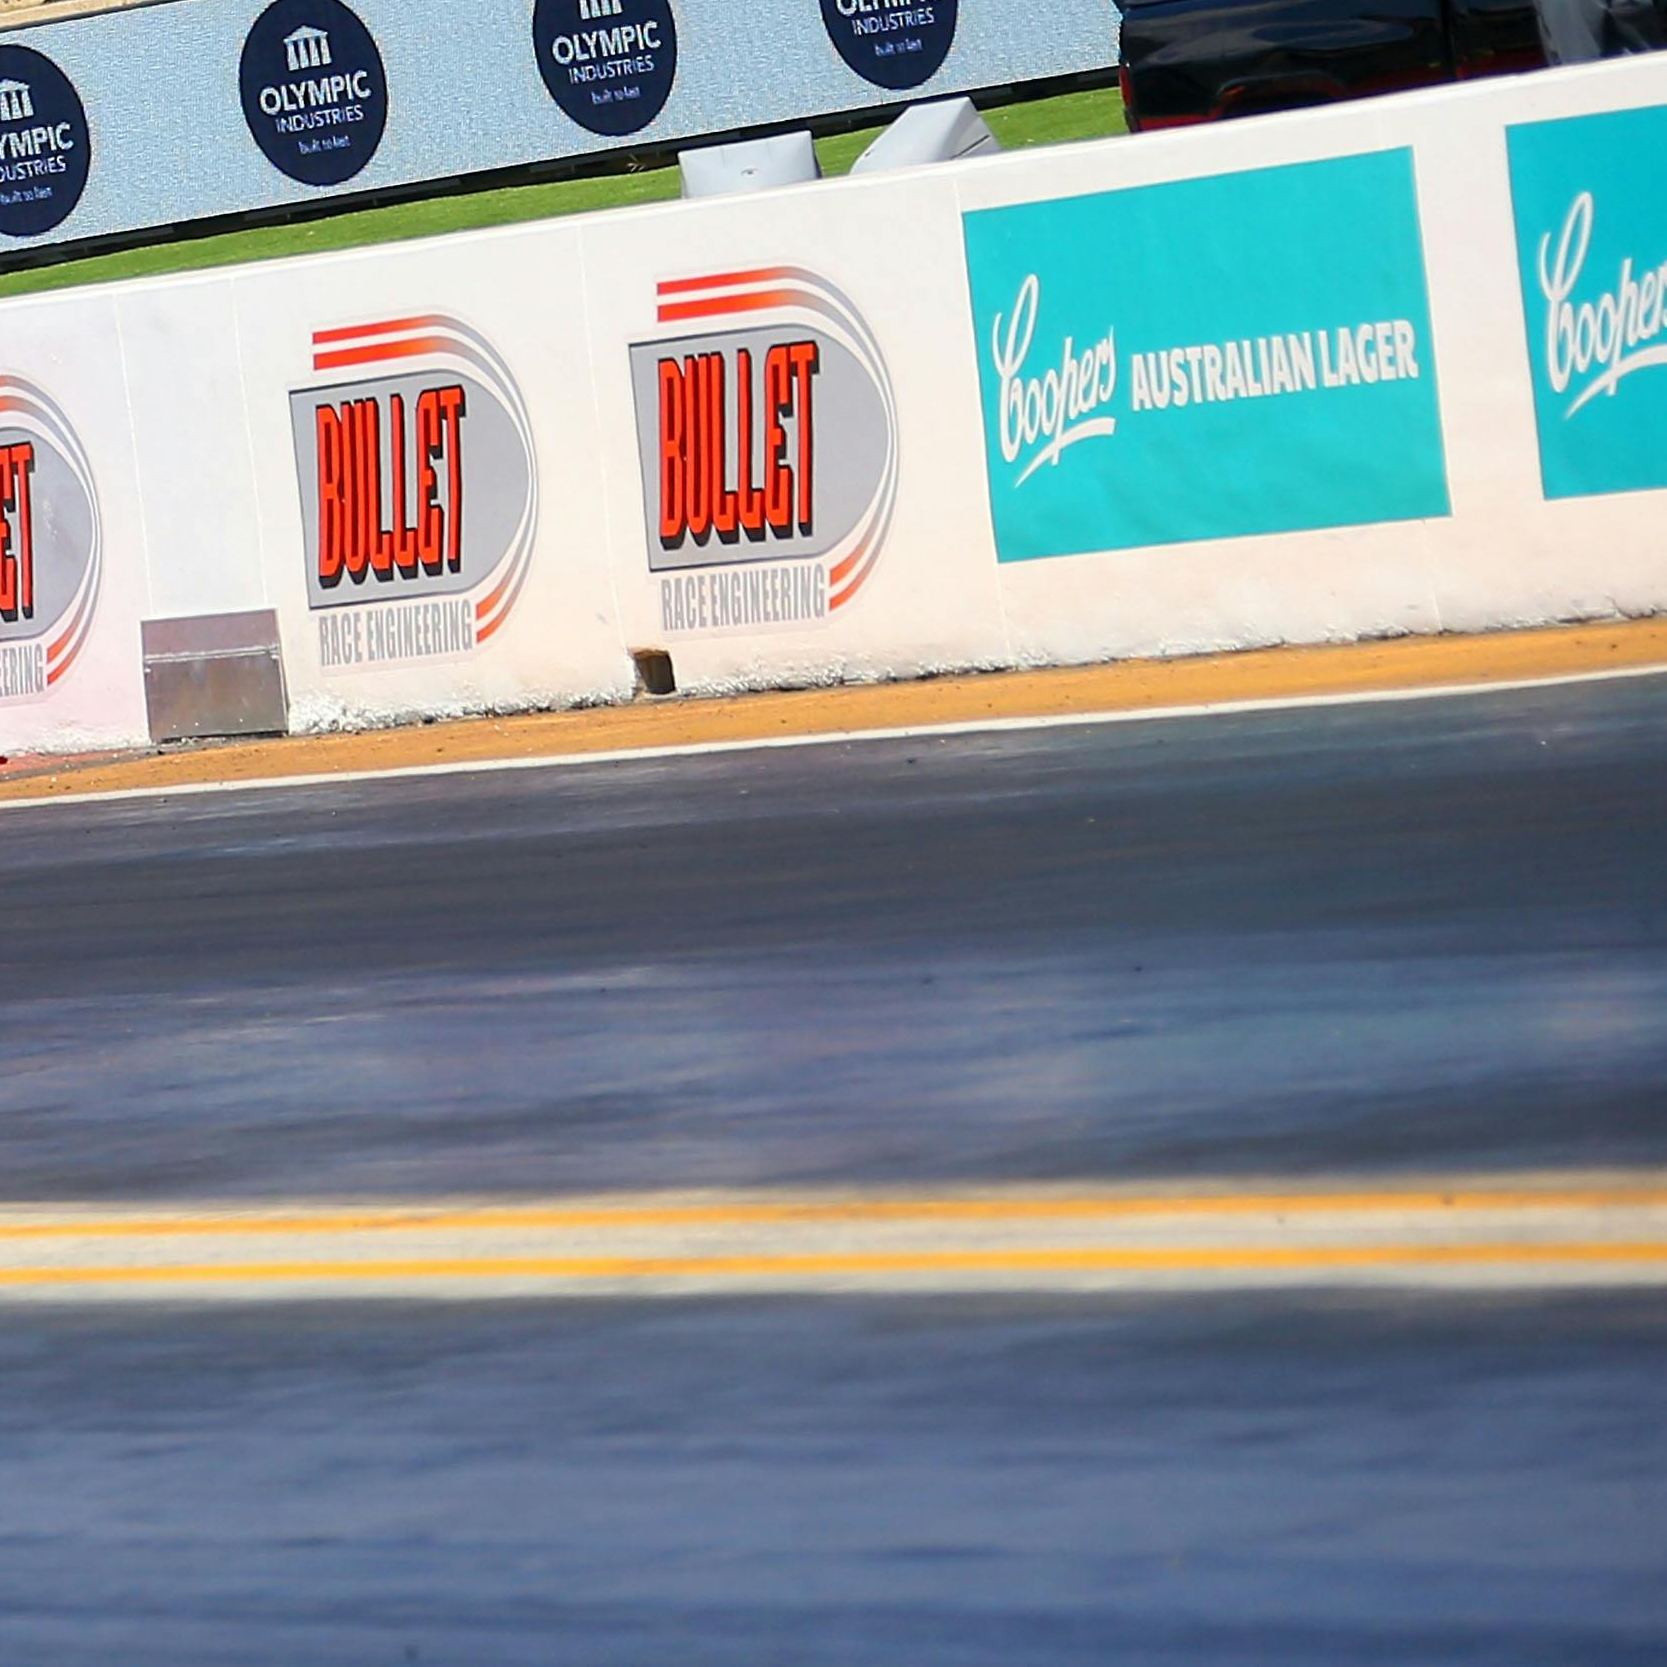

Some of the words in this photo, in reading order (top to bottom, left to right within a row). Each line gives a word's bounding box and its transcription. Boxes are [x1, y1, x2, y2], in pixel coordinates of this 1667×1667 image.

[552, 21, 661, 65] OLYMPIC
[852, 7, 935, 36] INDUSTRIES
[260, 70, 371, 115] OLYMPIC
[569, 54, 654, 84] INDUSTRIES
[275, 104, 364, 134] INDUSTRIES
[992, 273, 1116, 467] Coopers
[1130, 330, 1317, 411] AUSTRALIAN
[1317, 318, 1419, 388] LAGER
[656, 340, 820, 551] BULLET
[315, 385, 465, 589] BULLET
[661, 576, 708, 632] RACE
[710, 563, 828, 626] ENGINEERING
[319, 615, 364, 667] RACE
[366, 598, 474, 662] ENGINEERING
